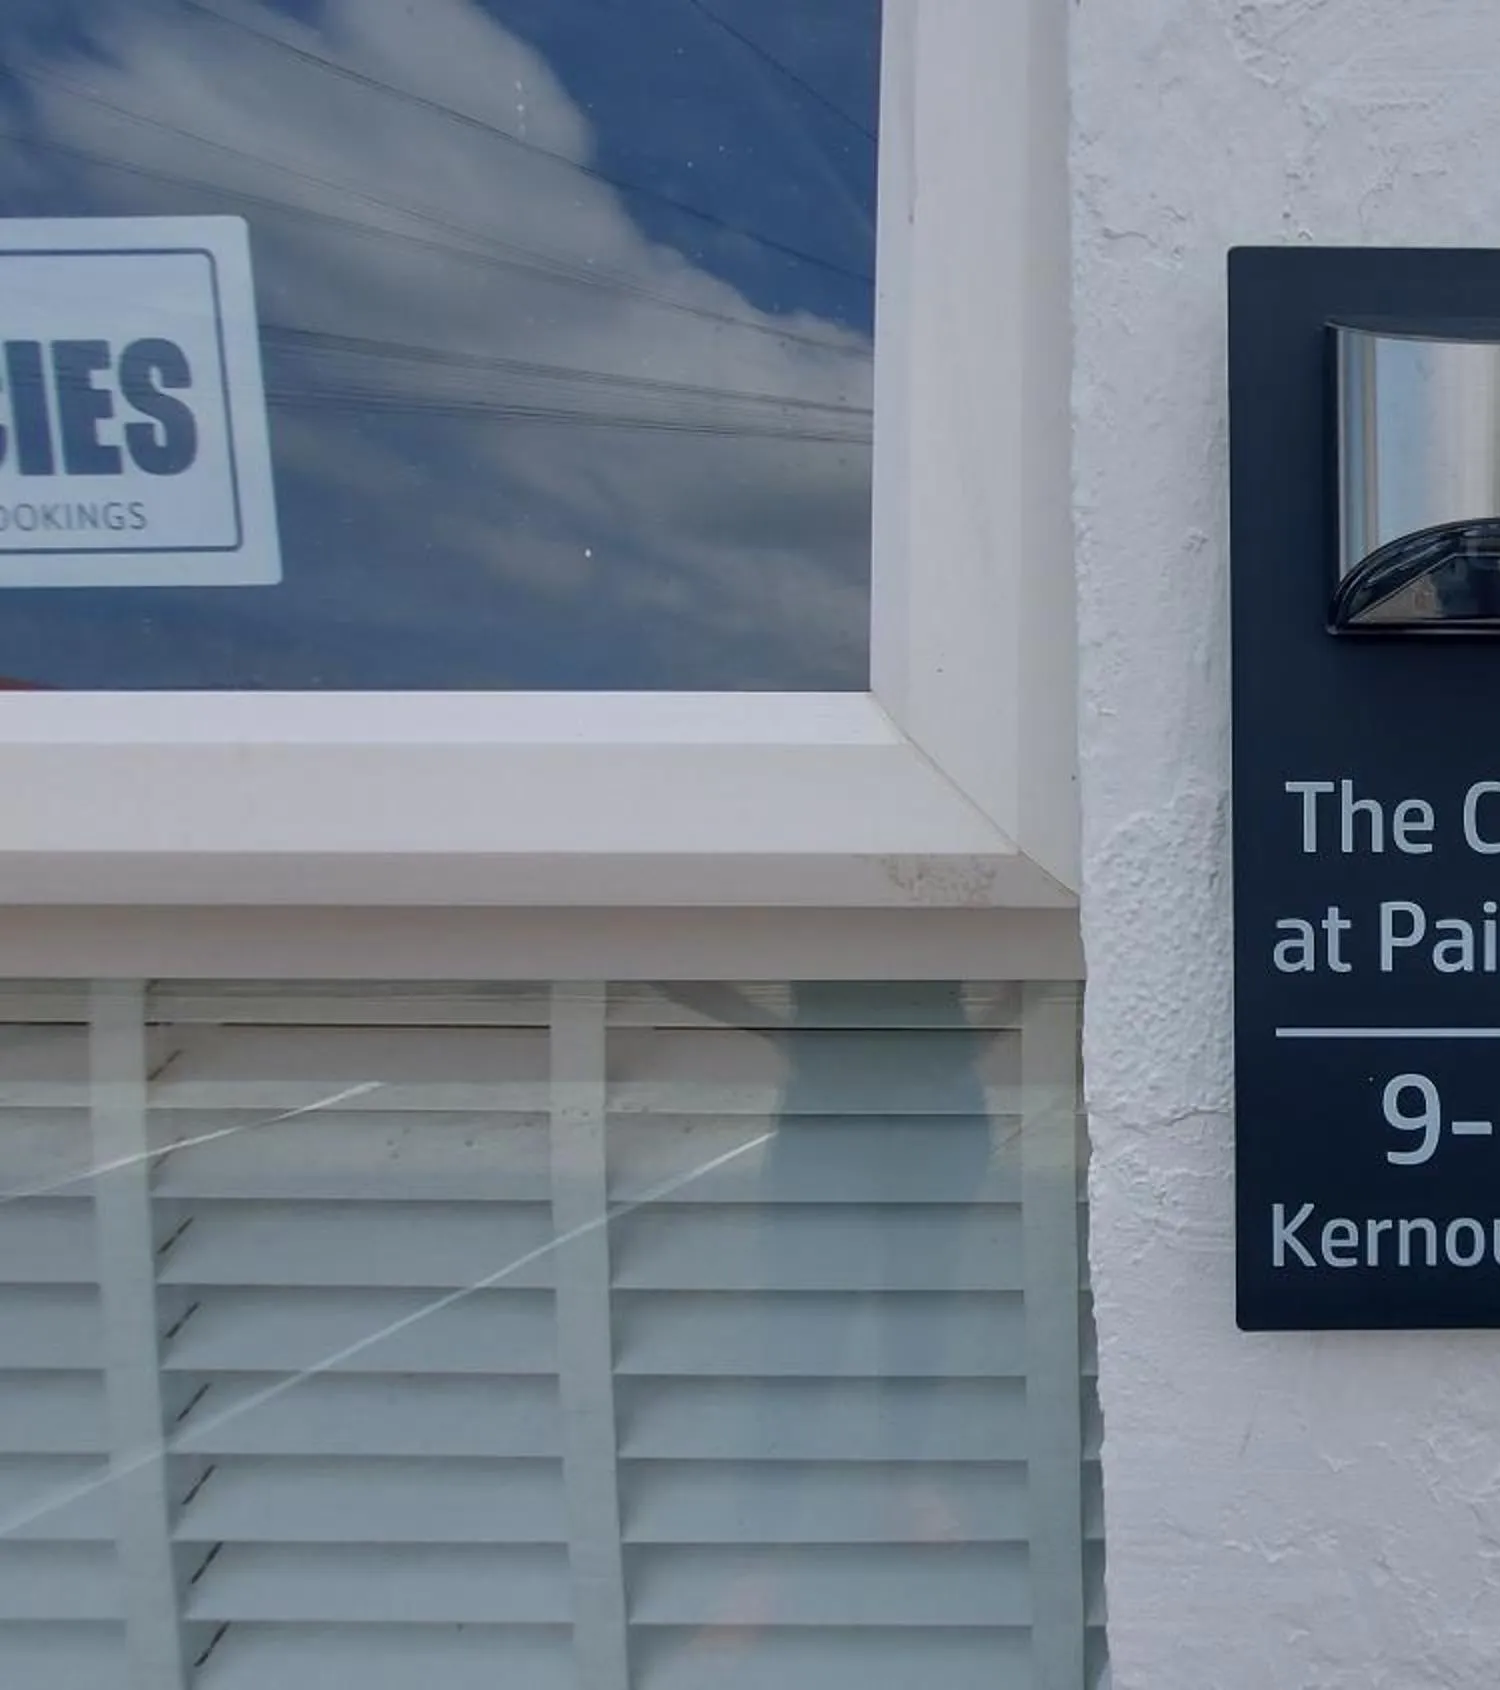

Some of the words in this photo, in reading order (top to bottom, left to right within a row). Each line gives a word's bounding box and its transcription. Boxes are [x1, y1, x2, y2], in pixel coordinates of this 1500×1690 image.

[0, 337, 198, 476] IES
[1286, 779, 1435, 853] The
[1272, 906, 1352, 973] at
